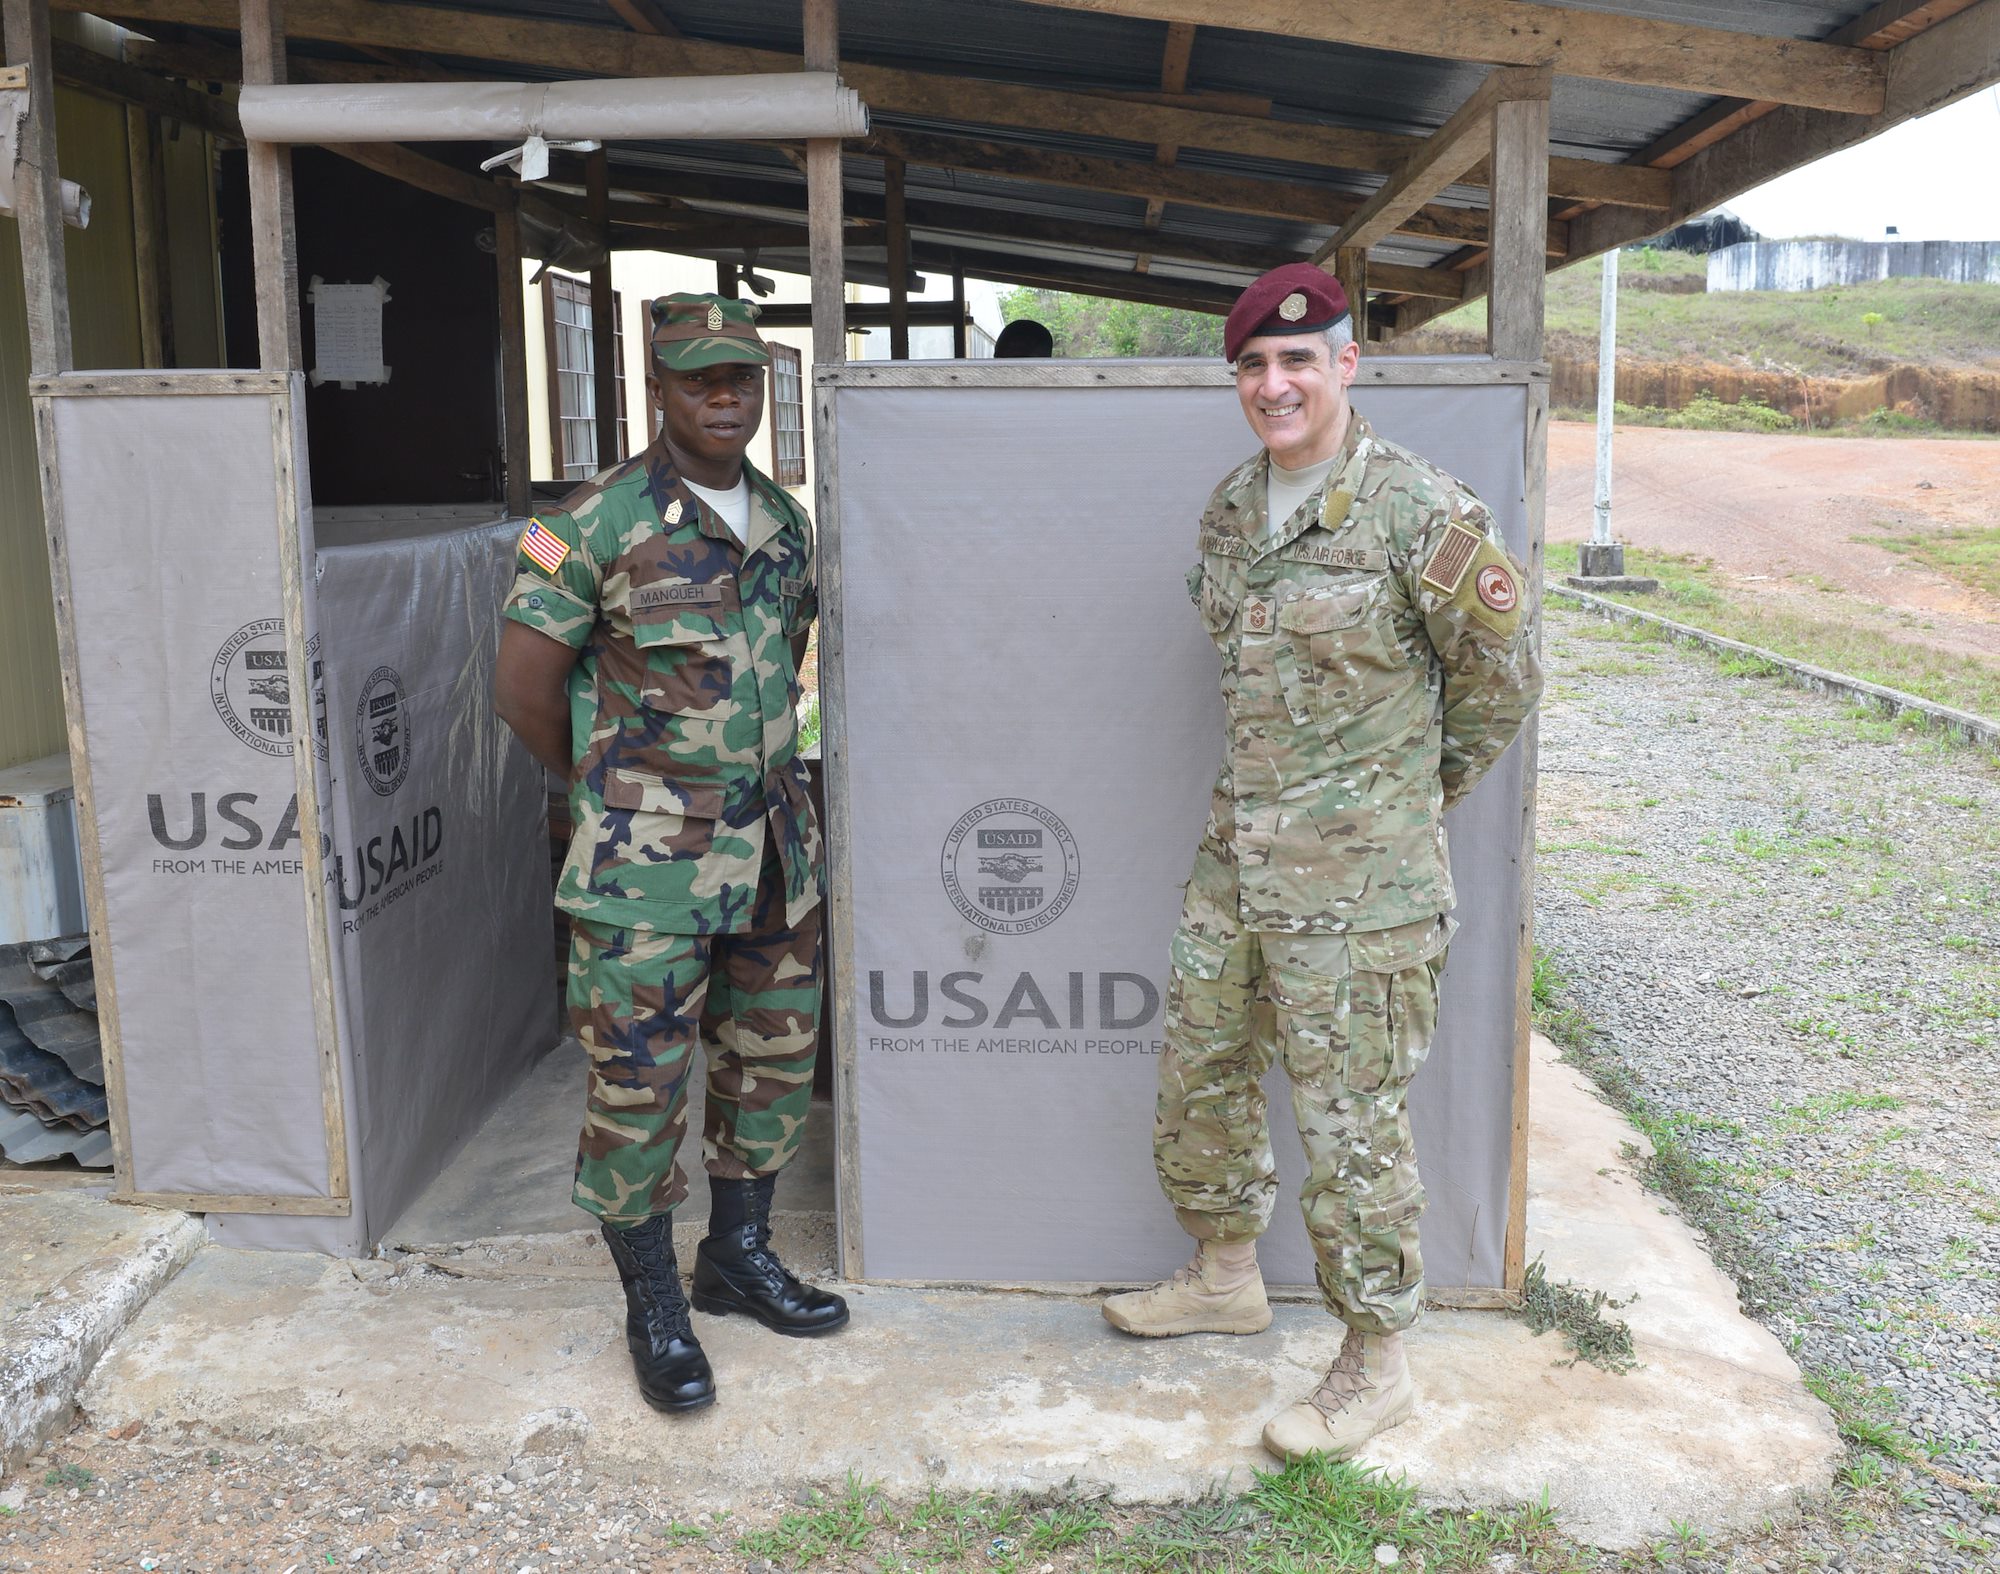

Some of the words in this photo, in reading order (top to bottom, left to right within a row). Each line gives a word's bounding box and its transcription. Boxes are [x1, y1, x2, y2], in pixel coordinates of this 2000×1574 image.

[1294, 542, 1310, 560] U.S.
[1312, 546, 1330, 562] AIR
[1331, 548, 1367, 566] FORCE
[640, 586, 704, 606] MANQUEH
[217, 631, 249, 666] UNITED
[249, 621, 286, 635] STATE
[252, 655, 288, 667] USA
[214, 692, 284, 754] INTERNATIONAL
[950, 809, 983, 844] UNITED
[984, 800, 1030, 814] STATES
[1030, 806, 1072, 845] AGENCY
[984, 833, 1038, 845] USAID
[153, 859, 206, 874] FROM
[211, 859, 247, 875] THE
[336, 806, 443, 910] USAID
[366, 902, 380, 922] THE
[416, 860, 444, 888] PEOPLE
[944, 870, 1013, 933] INTERNATIONAL
[1015, 871, 1077, 933] DEVELOPMENT
[868, 970, 1160, 1030] USAID
[869, 1037, 925, 1053] FROM
[930, 1038, 970, 1053] THE
[976, 1038, 1078, 1055] AMERICAN
[1084, 1040, 1162, 1055] PEOPLE
